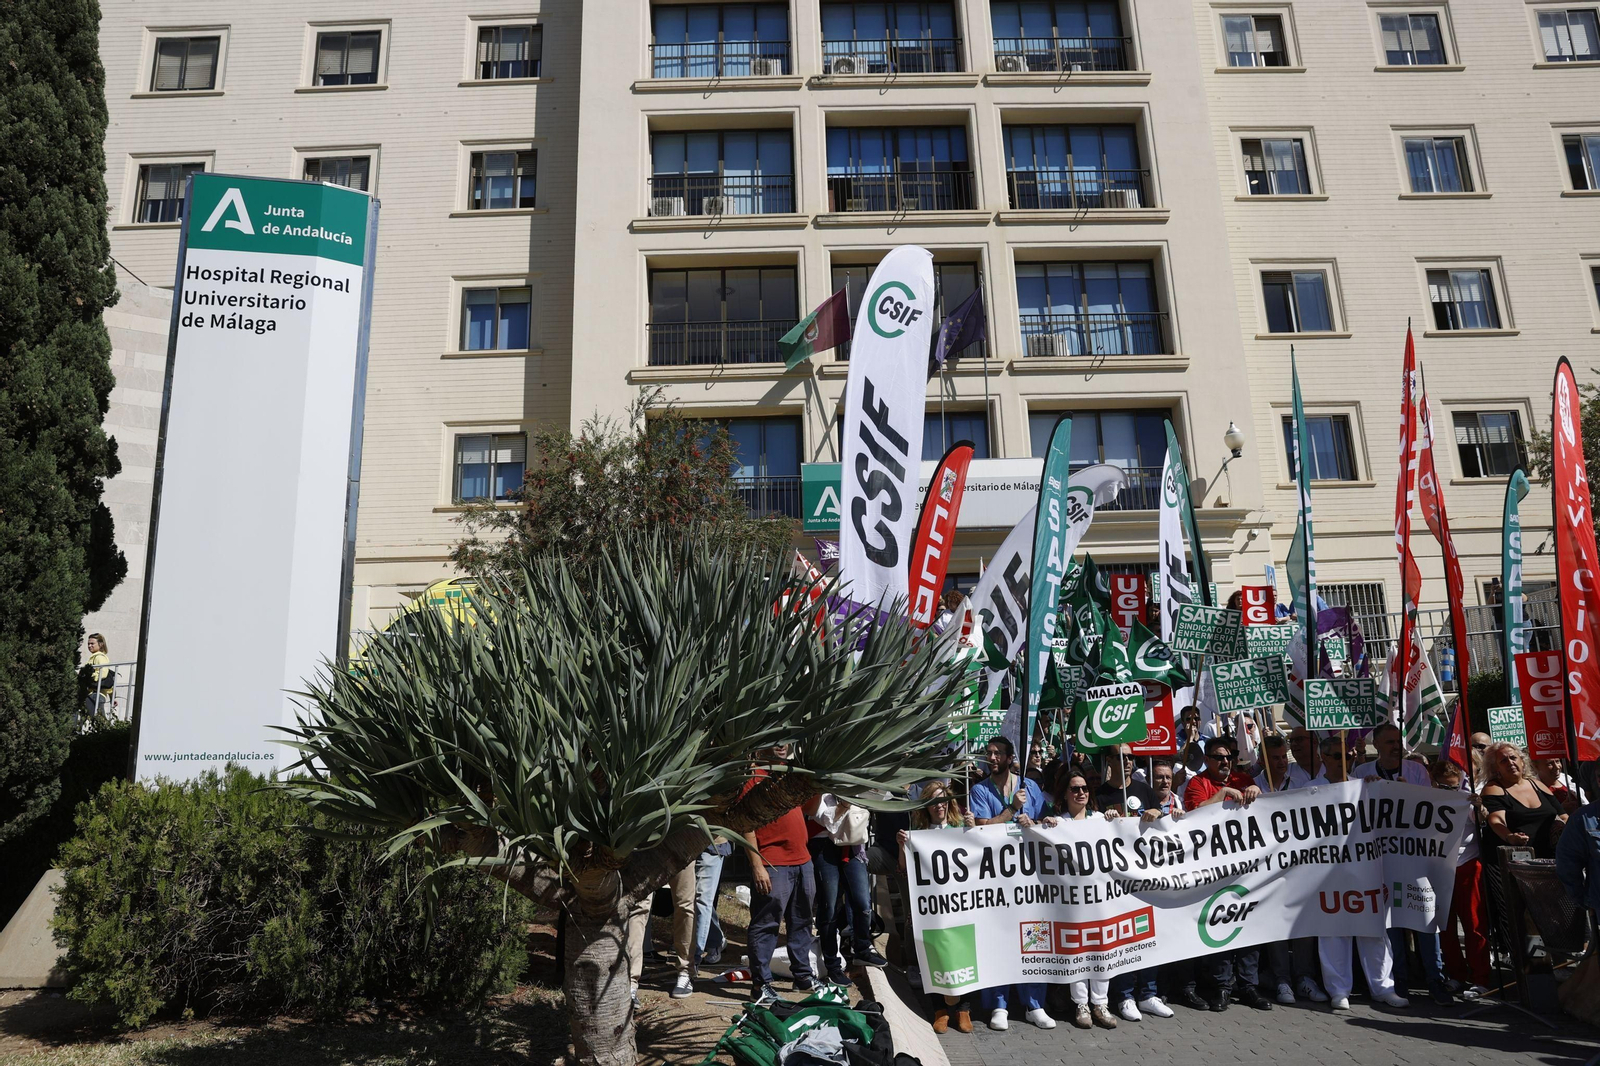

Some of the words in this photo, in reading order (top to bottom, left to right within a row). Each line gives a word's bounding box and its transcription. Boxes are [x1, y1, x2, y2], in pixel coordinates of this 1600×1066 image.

[264, 204, 305, 218] Junta
[262, 222, 280, 235] de
[283, 225, 353, 246] Andalucía
[186, 265, 265, 285] Hospital
[270, 269, 350, 294] Regional
[184, 290, 306, 311] Universitario
[878, 295, 922, 326] CSIF
[182, 312, 204, 328] de
[210, 312, 277, 335] Málaga
[851, 376, 909, 568] CSIF
[962, 482, 999, 492] ersitario
[1001, 482, 1012, 491] de
[1014, 481, 1040, 492] Málag
[1167, 476, 1176, 494] CS
[1117, 578, 1139, 626] UGT
[1246, 590, 1271, 626] UG
[1181, 606, 1240, 627] SATSE
[1178, 630, 1234, 642] ENFERMERIA
[1179, 622, 1222, 634] SINDICATO
[1245, 627, 1292, 640] SATSE
[1176, 637, 1231, 654] MALAGA
[1215, 656, 1282, 682] SATSE
[1218, 676, 1267, 690] SINDICATO
[1219, 682, 1284, 698] ENFERMERIA
[1308, 681, 1372, 698] SATSE
[1526, 655, 1562, 728] UGT
[1220, 690, 1287, 710] MALAGA
[1309, 698, 1358, 706] SINDICATO
[1310, 705, 1373, 714] ENFERMERIA
[1102, 703, 1138, 723] CSIF
[1310, 713, 1373, 728] MALAGA
[1490, 708, 1522, 724] SATSE
[1493, 729, 1524, 737] ENFERMERIA
[144, 752, 274, 762] www.juntadeandalucia.es
[914, 848, 969, 886] LOS
[979, 837, 1128, 879] ACUERDOS
[1134, 834, 1185, 869] SON
[1189, 816, 1266, 861] PARA
[1271, 798, 1456, 843] CUMPLIRLOS
[918, 888, 1010, 915] CONSEJERA,
[1014, 885, 1079, 905] CUMPLE
[1084, 885, 1102, 904] EL
[1106, 878, 1170, 901] ACUERDO
[1171, 873, 1191, 891] DE
[1192, 859, 1259, 888] PRIMARIA
[1264, 854, 1273, 871] Y
[1278, 845, 1352, 870] CARRERA
[1355, 836, 1447, 861] PROFESIONAL
[1319, 889, 1380, 913] UGT
[1209, 901, 1259, 926] CSIF
[1060, 918, 1133, 948] CCOO
[1021, 955, 1070, 965] federación
[1073, 955, 1083, 963] de
[1085, 950, 1117, 961] sanidad
[1125, 940, 1157, 954] sectores
[933, 966, 975, 985] SATSE
[1022, 965, 1090, 976] sociosanitarios
[1093, 965, 1105, 973] de
[1107, 955, 1142, 972] Andalucía
